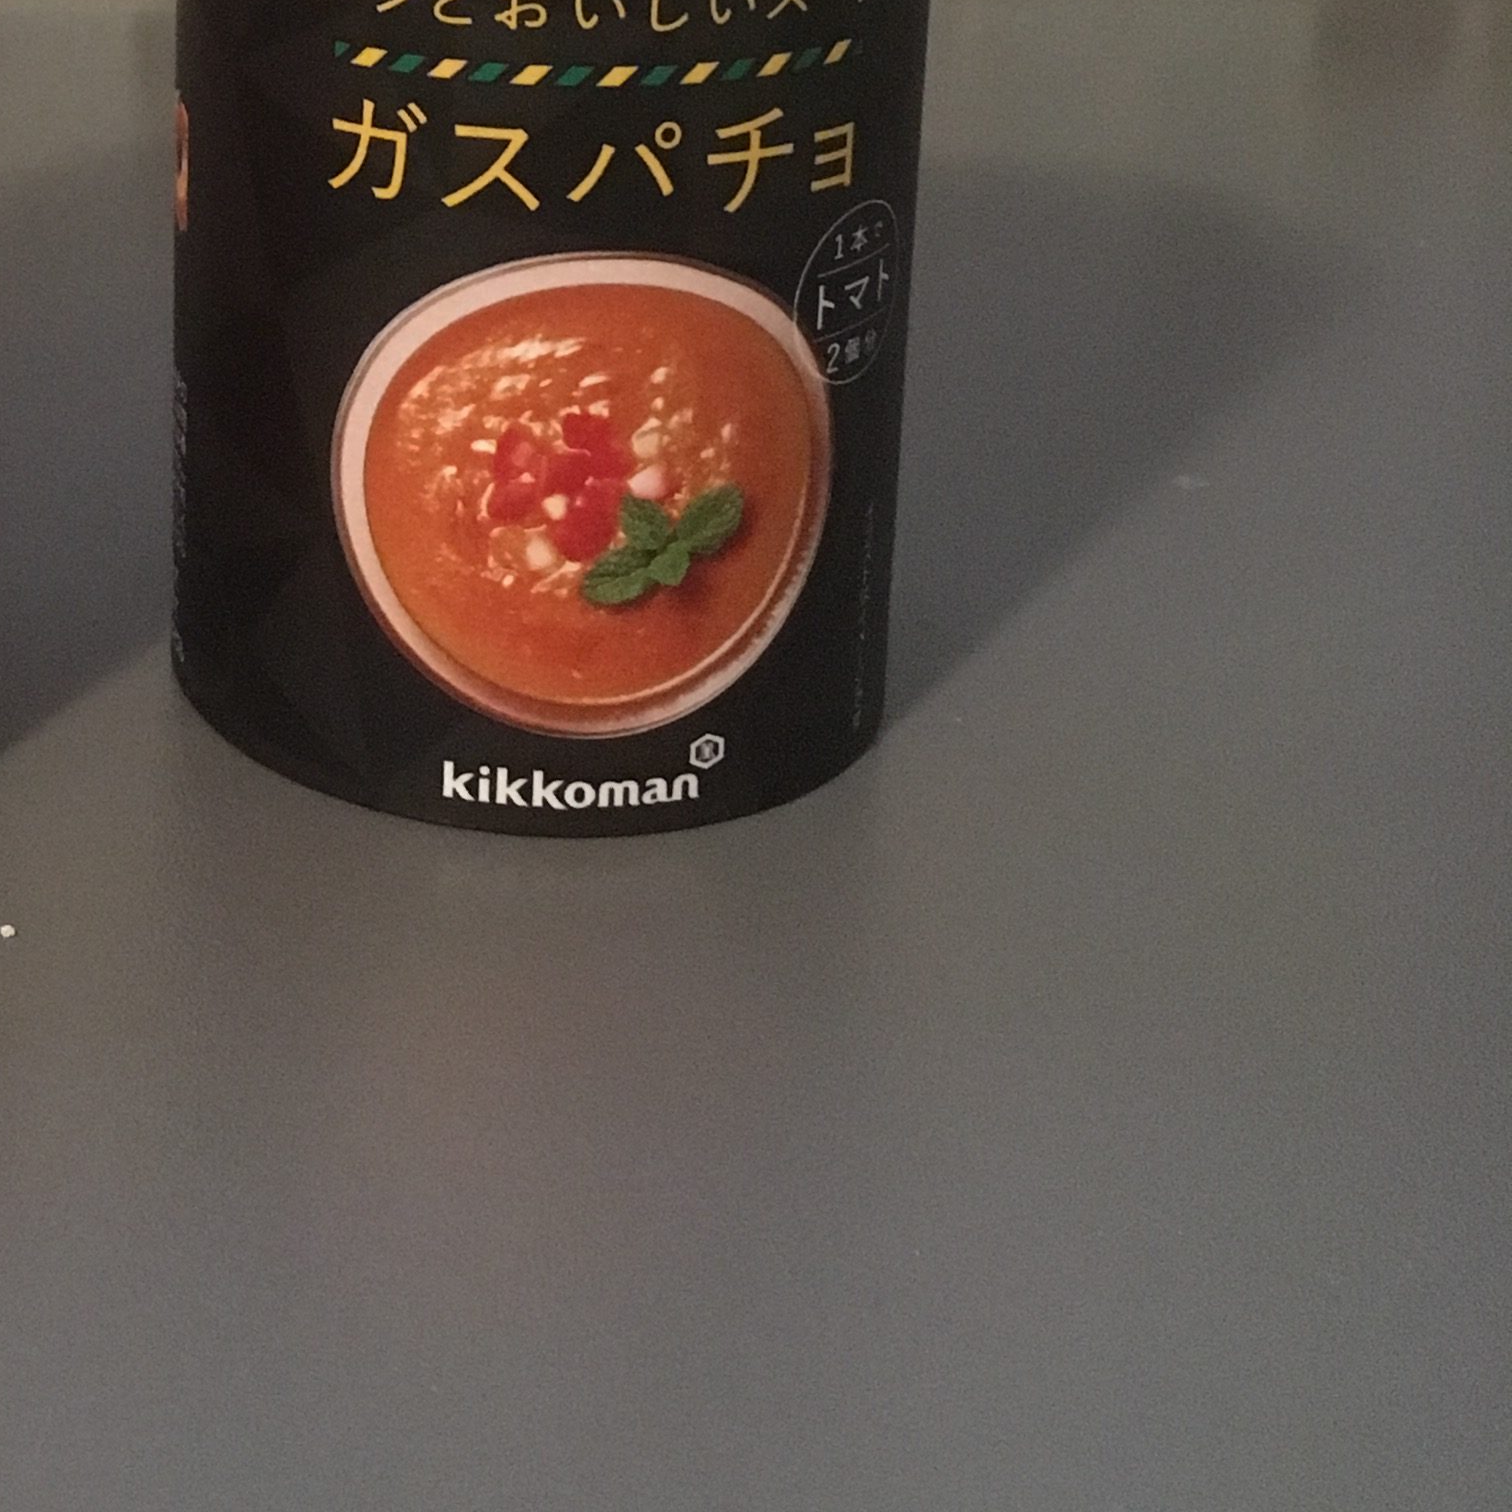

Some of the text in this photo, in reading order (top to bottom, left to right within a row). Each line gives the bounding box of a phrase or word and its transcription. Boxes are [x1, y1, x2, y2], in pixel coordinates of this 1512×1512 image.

[327, 97, 857, 213] ガスパチョ
[816, 258, 890, 331] トマト
[441, 759, 701, 811] kikkoman
